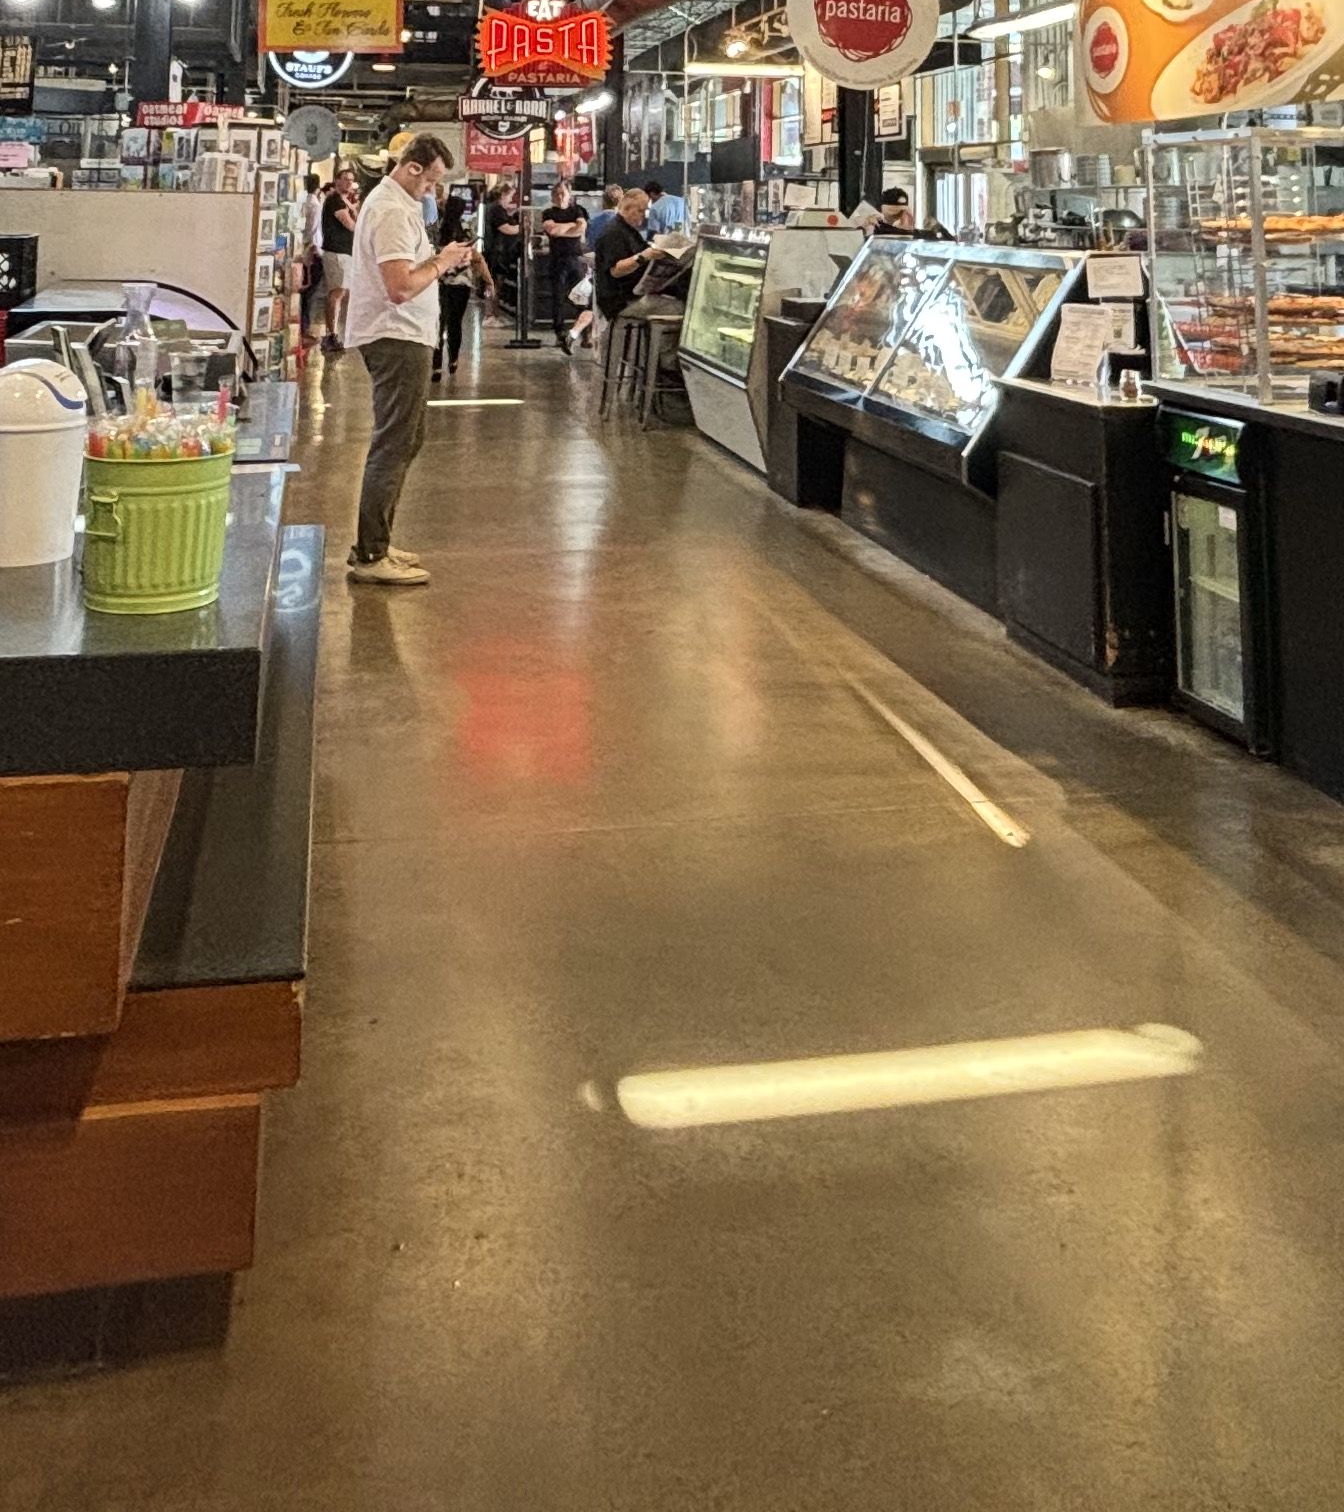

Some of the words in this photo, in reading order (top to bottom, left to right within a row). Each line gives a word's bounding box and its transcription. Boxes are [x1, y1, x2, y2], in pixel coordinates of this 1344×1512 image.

[487, 18, 599, 71] PASTA
[508, 72, 581, 84] PASTARIA
[142, 103, 188, 115] oatmeal
[470, 144, 519, 155] INDIA
